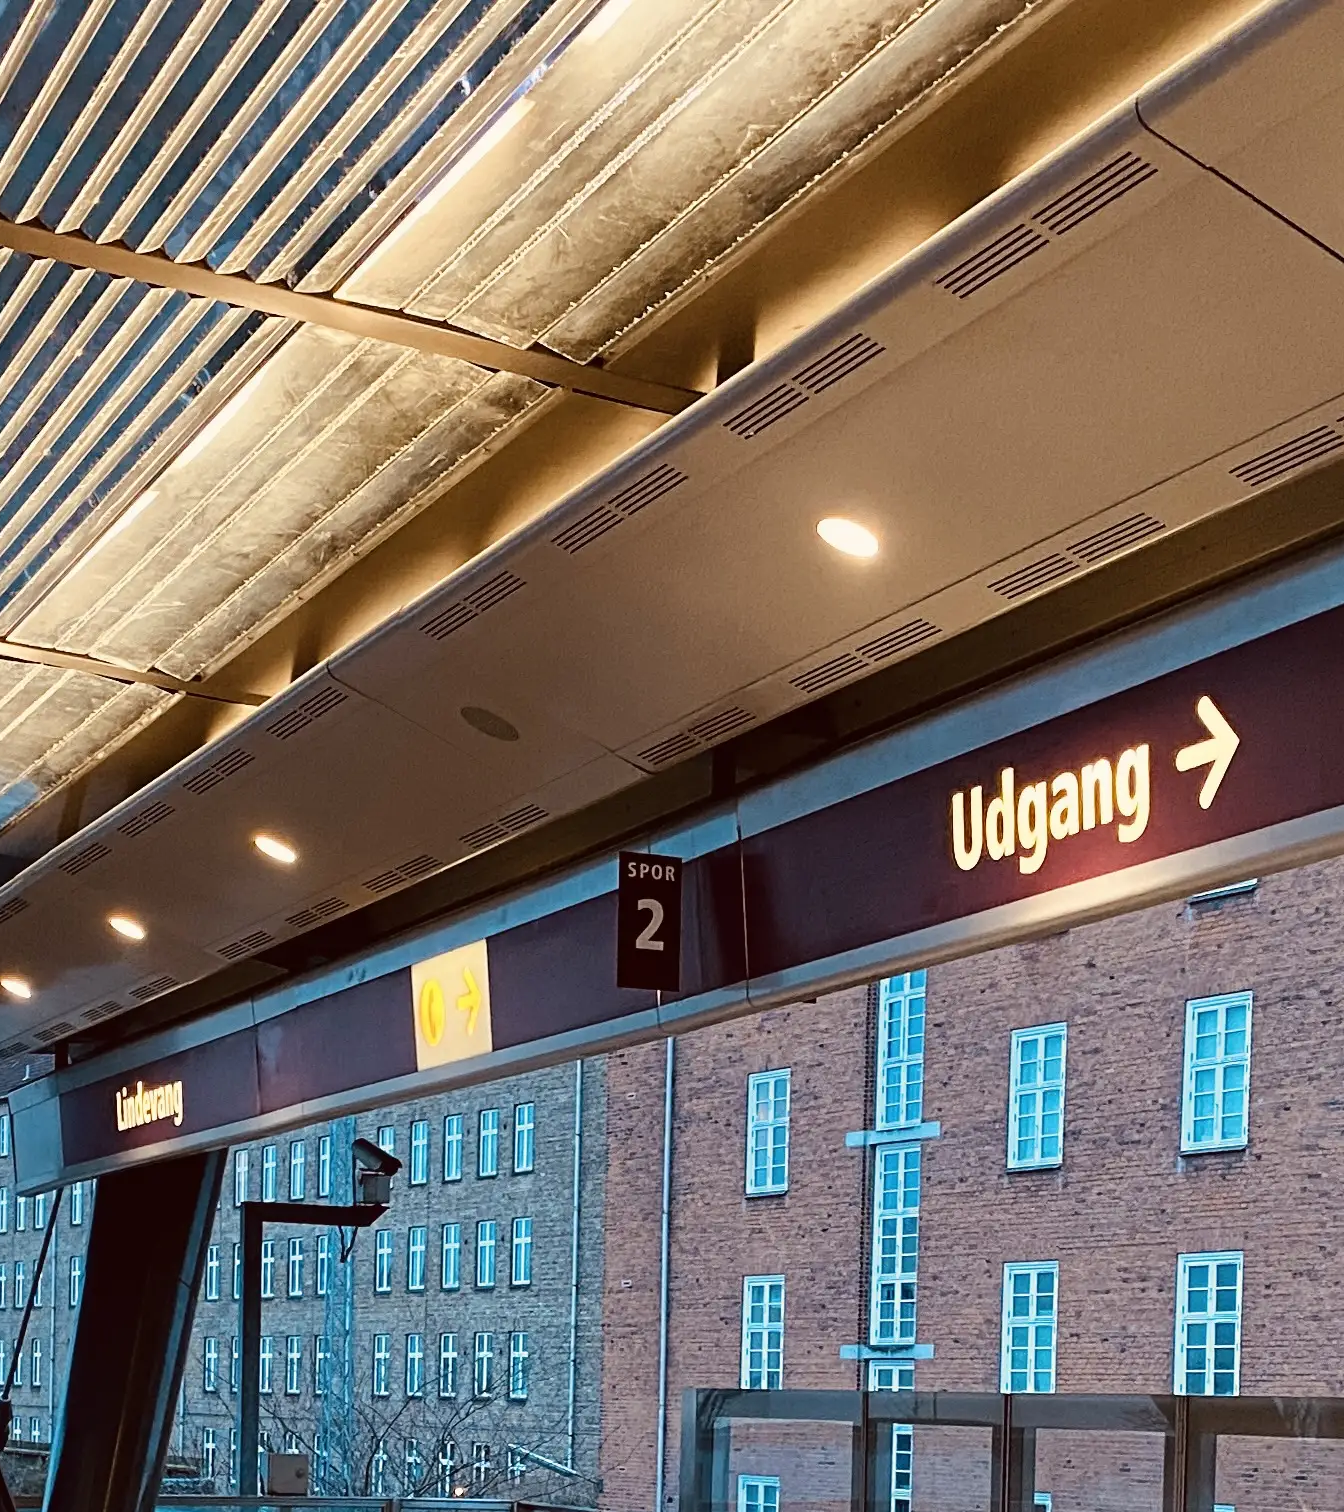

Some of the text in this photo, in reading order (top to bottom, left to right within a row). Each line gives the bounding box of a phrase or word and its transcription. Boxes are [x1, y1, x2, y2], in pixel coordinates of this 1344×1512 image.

[952, 743, 1150, 874] Udgang
[628, 862, 675, 881] SPOR
[636, 899, 664, 951] 2
[116, 1080, 183, 1132] Lindevang
